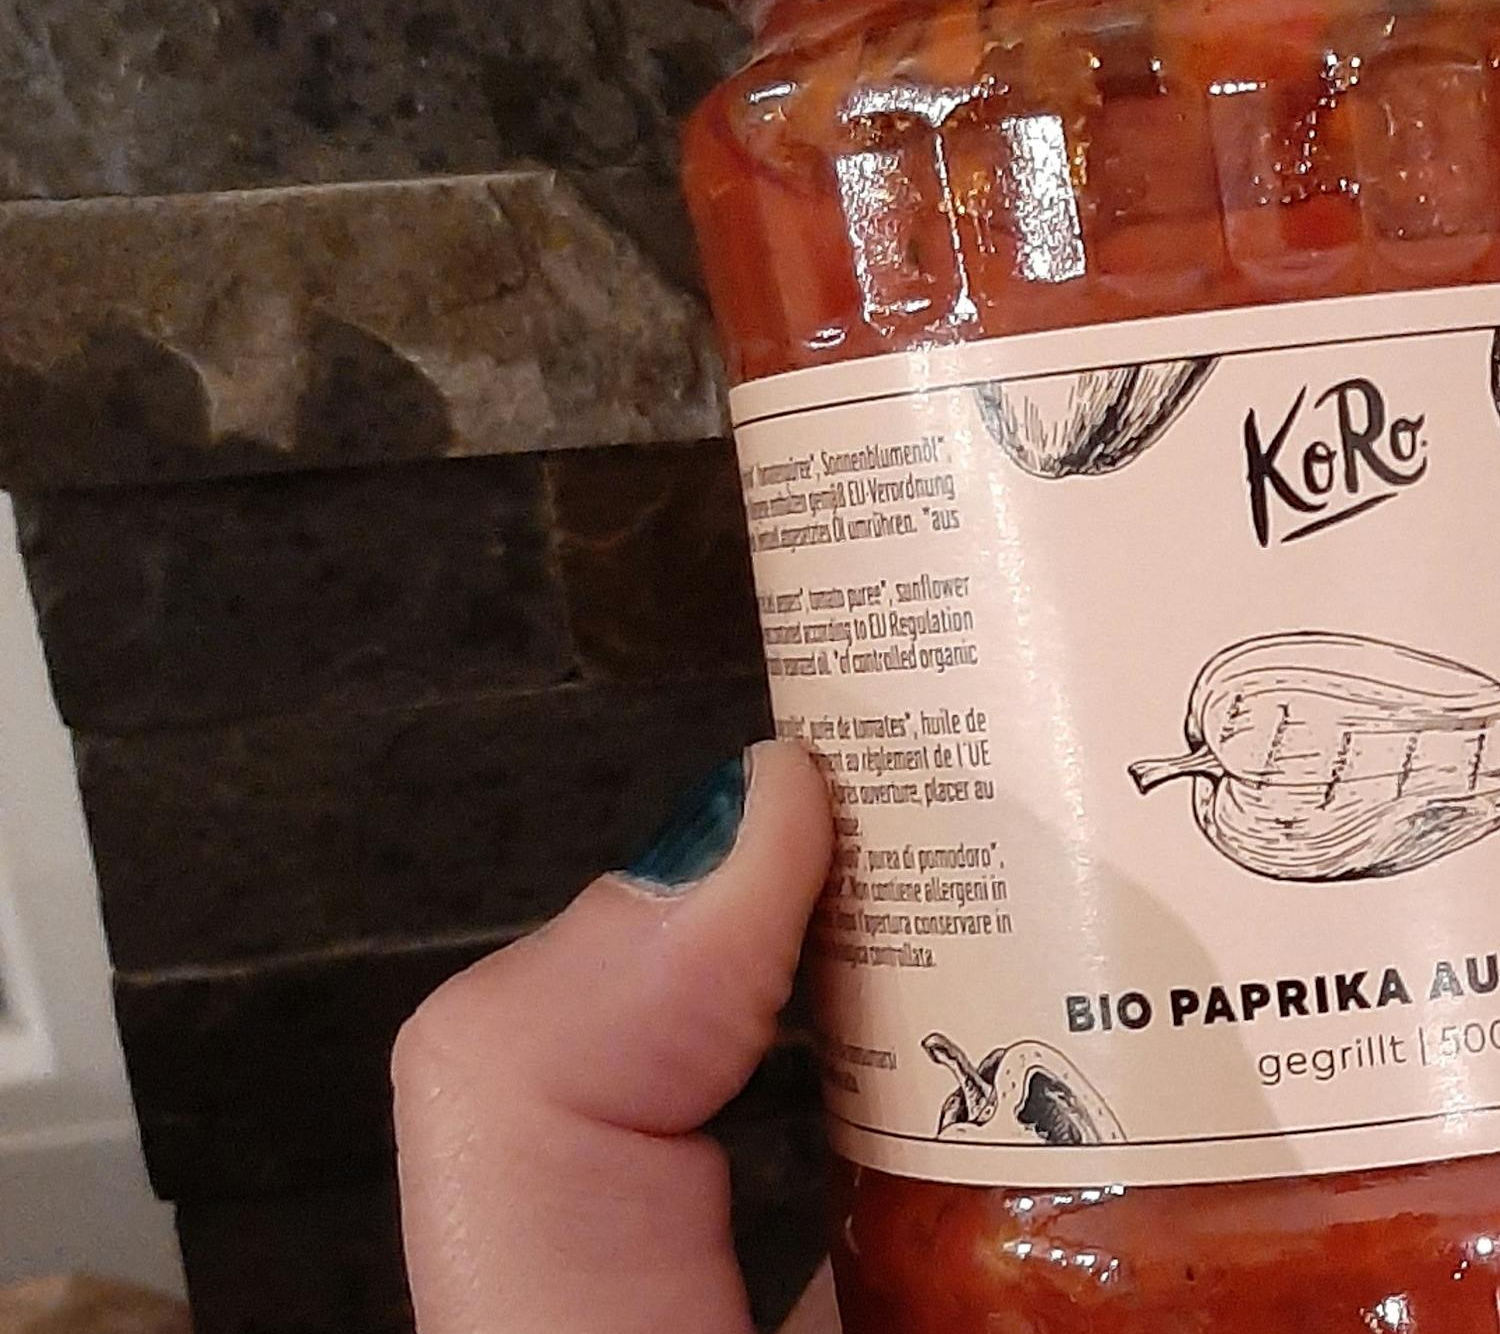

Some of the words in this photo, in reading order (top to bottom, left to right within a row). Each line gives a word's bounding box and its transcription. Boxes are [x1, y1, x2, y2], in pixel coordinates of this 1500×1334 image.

[1244, 377, 1428, 548] KoRo
[896, 574, 969, 604] sunflower
[854, 617, 867, 641] to
[868, 612, 887, 640] EU
[889, 607, 973, 641] Regulation
[919, 638, 978, 673] organic
[920, 707, 961, 737] huile
[965, 707, 987, 734] de
[934, 743, 952, 769] de
[924, 776, 969, 807] placer
[974, 779, 995, 801] au
[924, 876, 989, 908] allergeni
[991, 874, 1008, 901] in
[914, 911, 992, 936] conservare
[996, 907, 1013, 934] in
[1066, 991, 1153, 1033] BIO
[1169, 967, 1413, 1027] PAPRIKA
[1258, 1034, 1408, 1086] gegrillt
